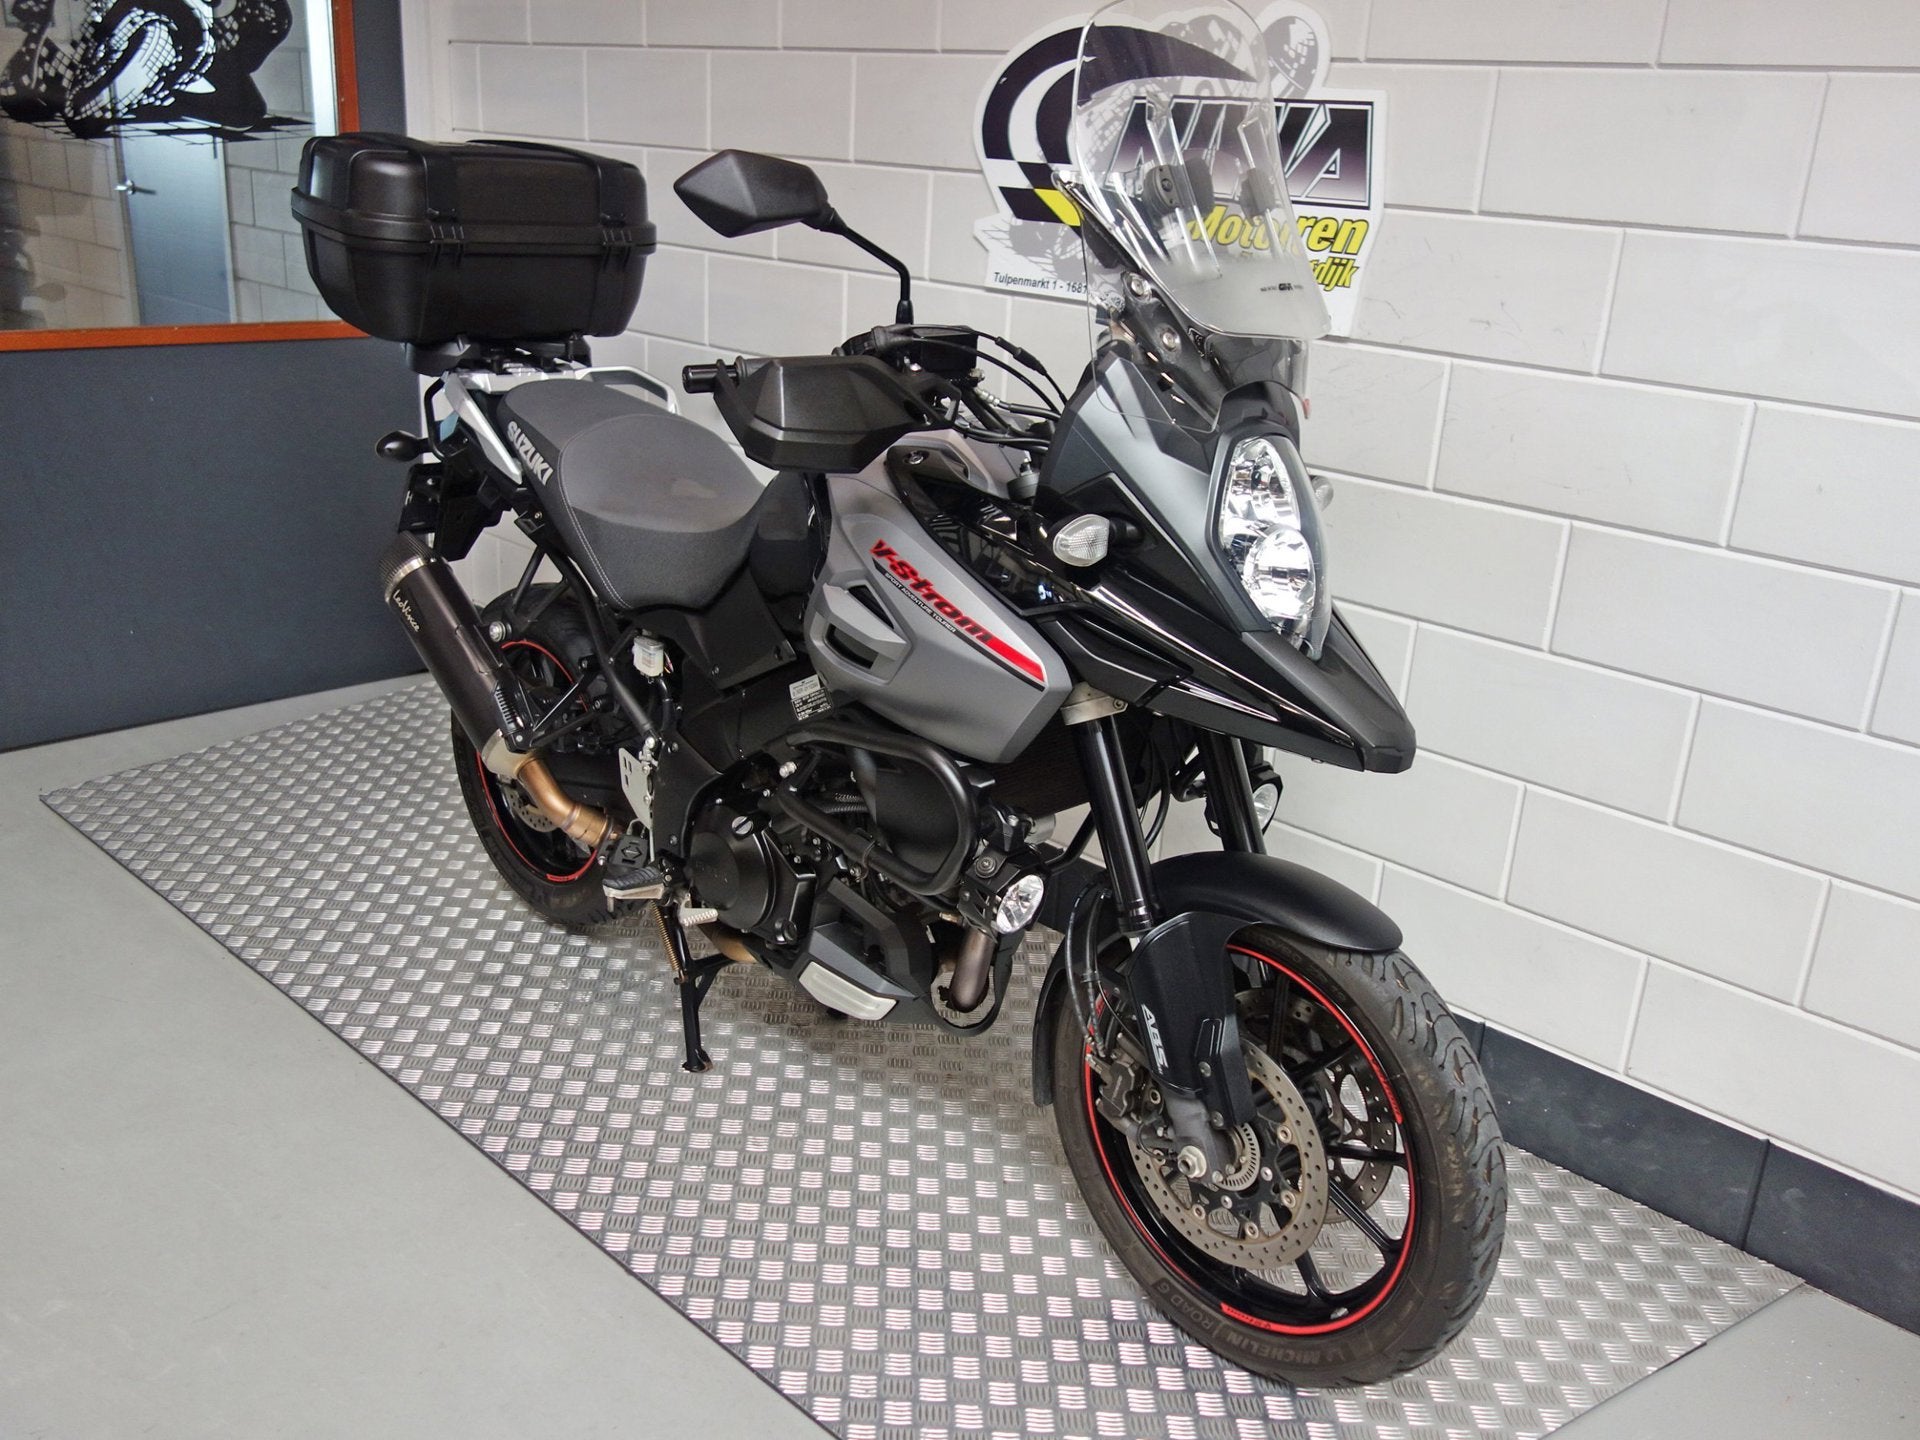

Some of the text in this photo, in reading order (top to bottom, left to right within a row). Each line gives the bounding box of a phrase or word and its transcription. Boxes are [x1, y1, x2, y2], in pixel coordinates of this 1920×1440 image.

[1187, 205, 1370, 255] Motoren
[994, 272, 1050, 289] Tulpenmarkt
[1053, 280, 1058, 290] 1
[1067, 281, 1087, 294] 1681
[507, 420, 554, 486] SUZUKI
[884, 571, 957, 633] SPORT ADVENTURE TOURER
[1140, 1003, 1169, 1069] ABS
[1170, 1294, 1212, 1330] ROAD
[1226, 1331, 1321, 1365] MICHELIN
